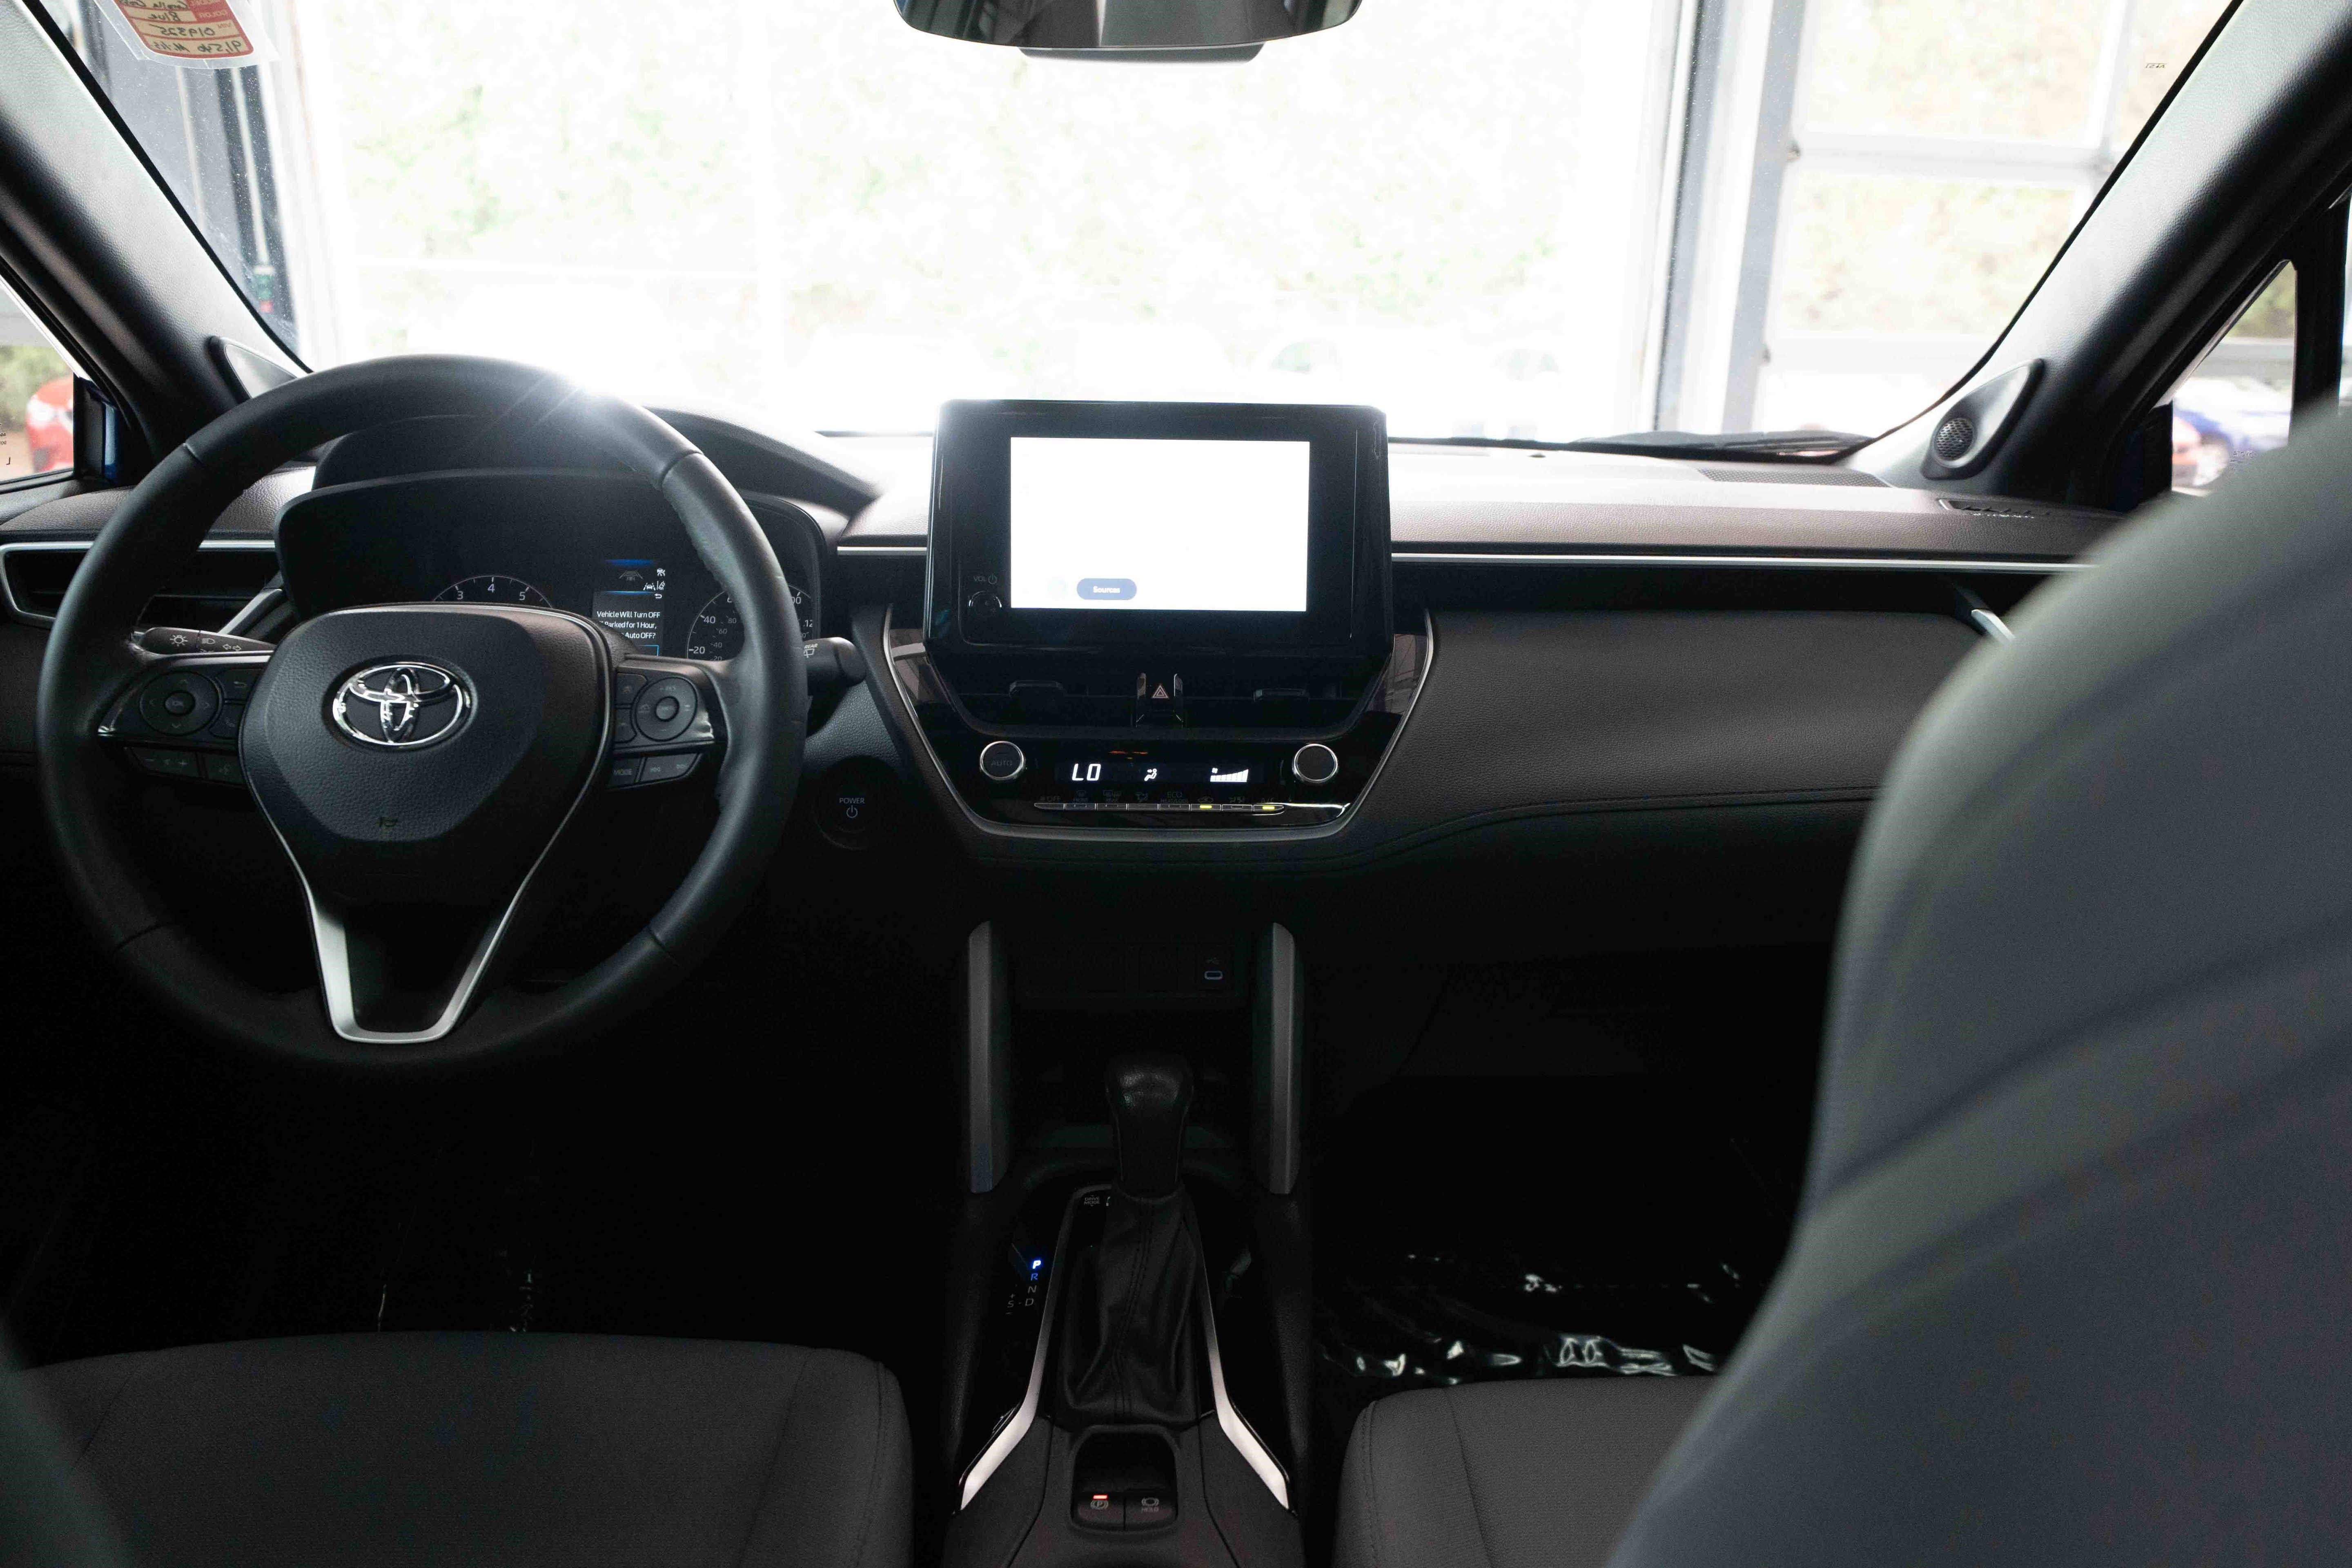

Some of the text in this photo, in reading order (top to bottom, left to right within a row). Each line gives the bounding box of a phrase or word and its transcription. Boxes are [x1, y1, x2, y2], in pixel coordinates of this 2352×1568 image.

[488, 584, 495, 592] 4
[457, 591, 463, 600] 3
[519, 592, 526, 600] 5
[693, 646, 705, 654] 20
[1072, 763, 1101, 781] LO
[1032, 1260, 1041, 1270] P
[1027, 1285, 1037, 1293] N
[1025, 1298, 1034, 1306] D
